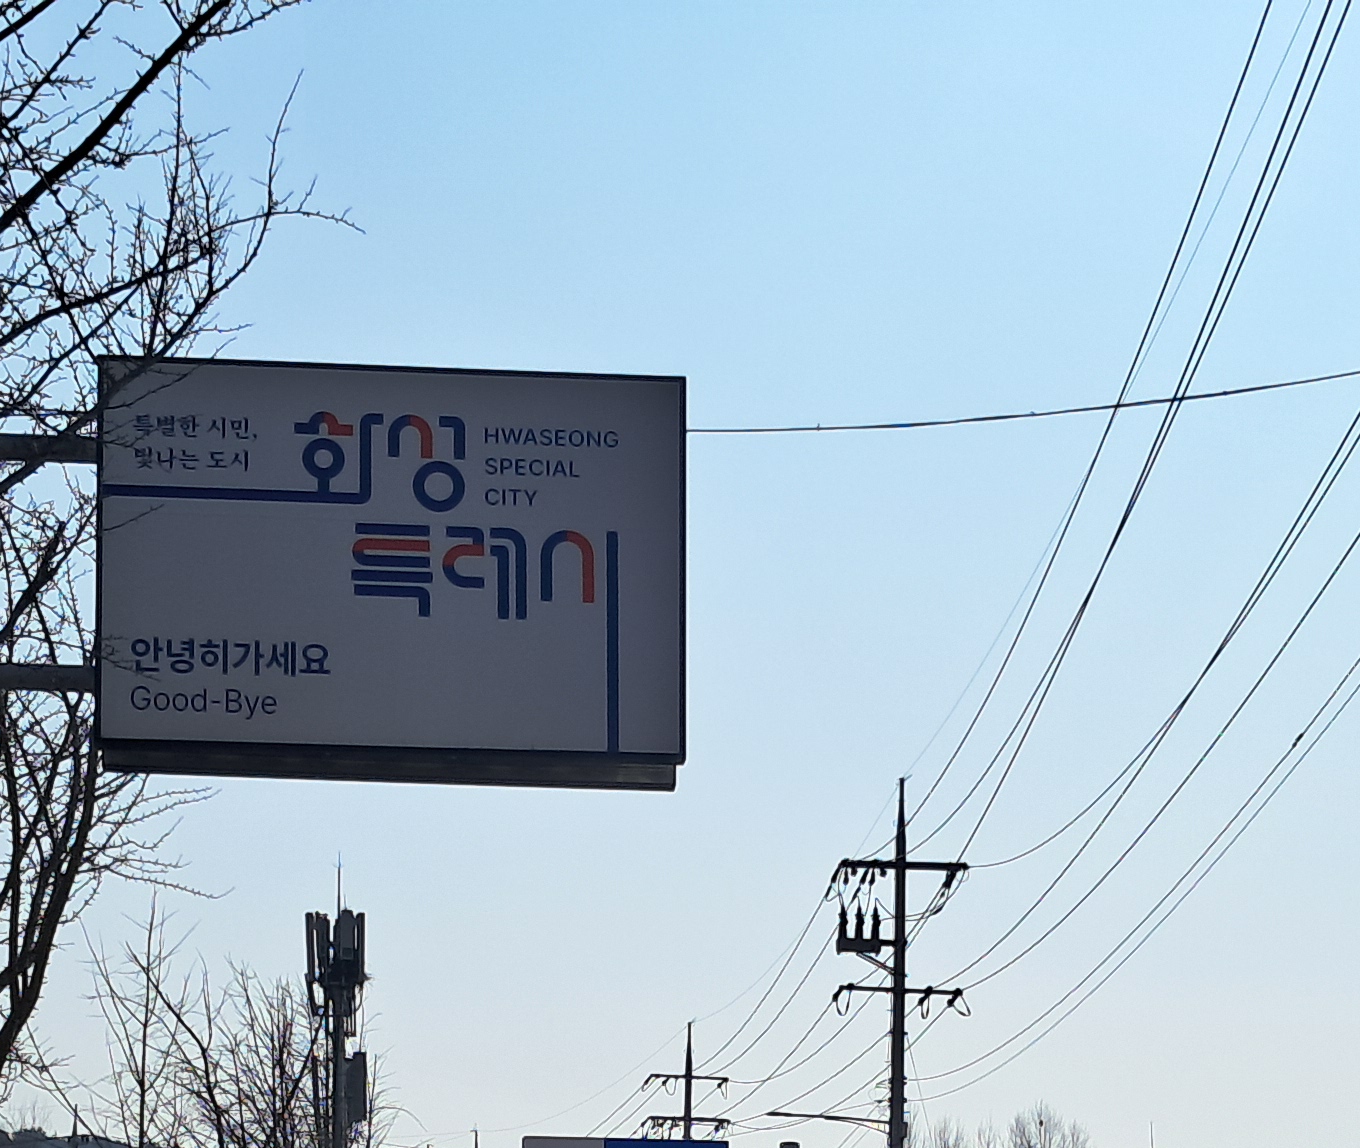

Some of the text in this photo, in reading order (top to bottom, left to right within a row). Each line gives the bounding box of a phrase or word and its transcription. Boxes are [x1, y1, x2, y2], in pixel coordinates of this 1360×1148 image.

[132, 413, 257, 440] 특별한 시민,
[484, 427, 619, 448] HWASEONG
[134, 446, 249, 472] 빛나는 도시
[484, 458, 580, 478] SPECIAL
[484, 488, 538, 507] CITY
[130, 637, 331, 677] 안녕히가세요
[130, 685, 278, 720] Good-Bye
